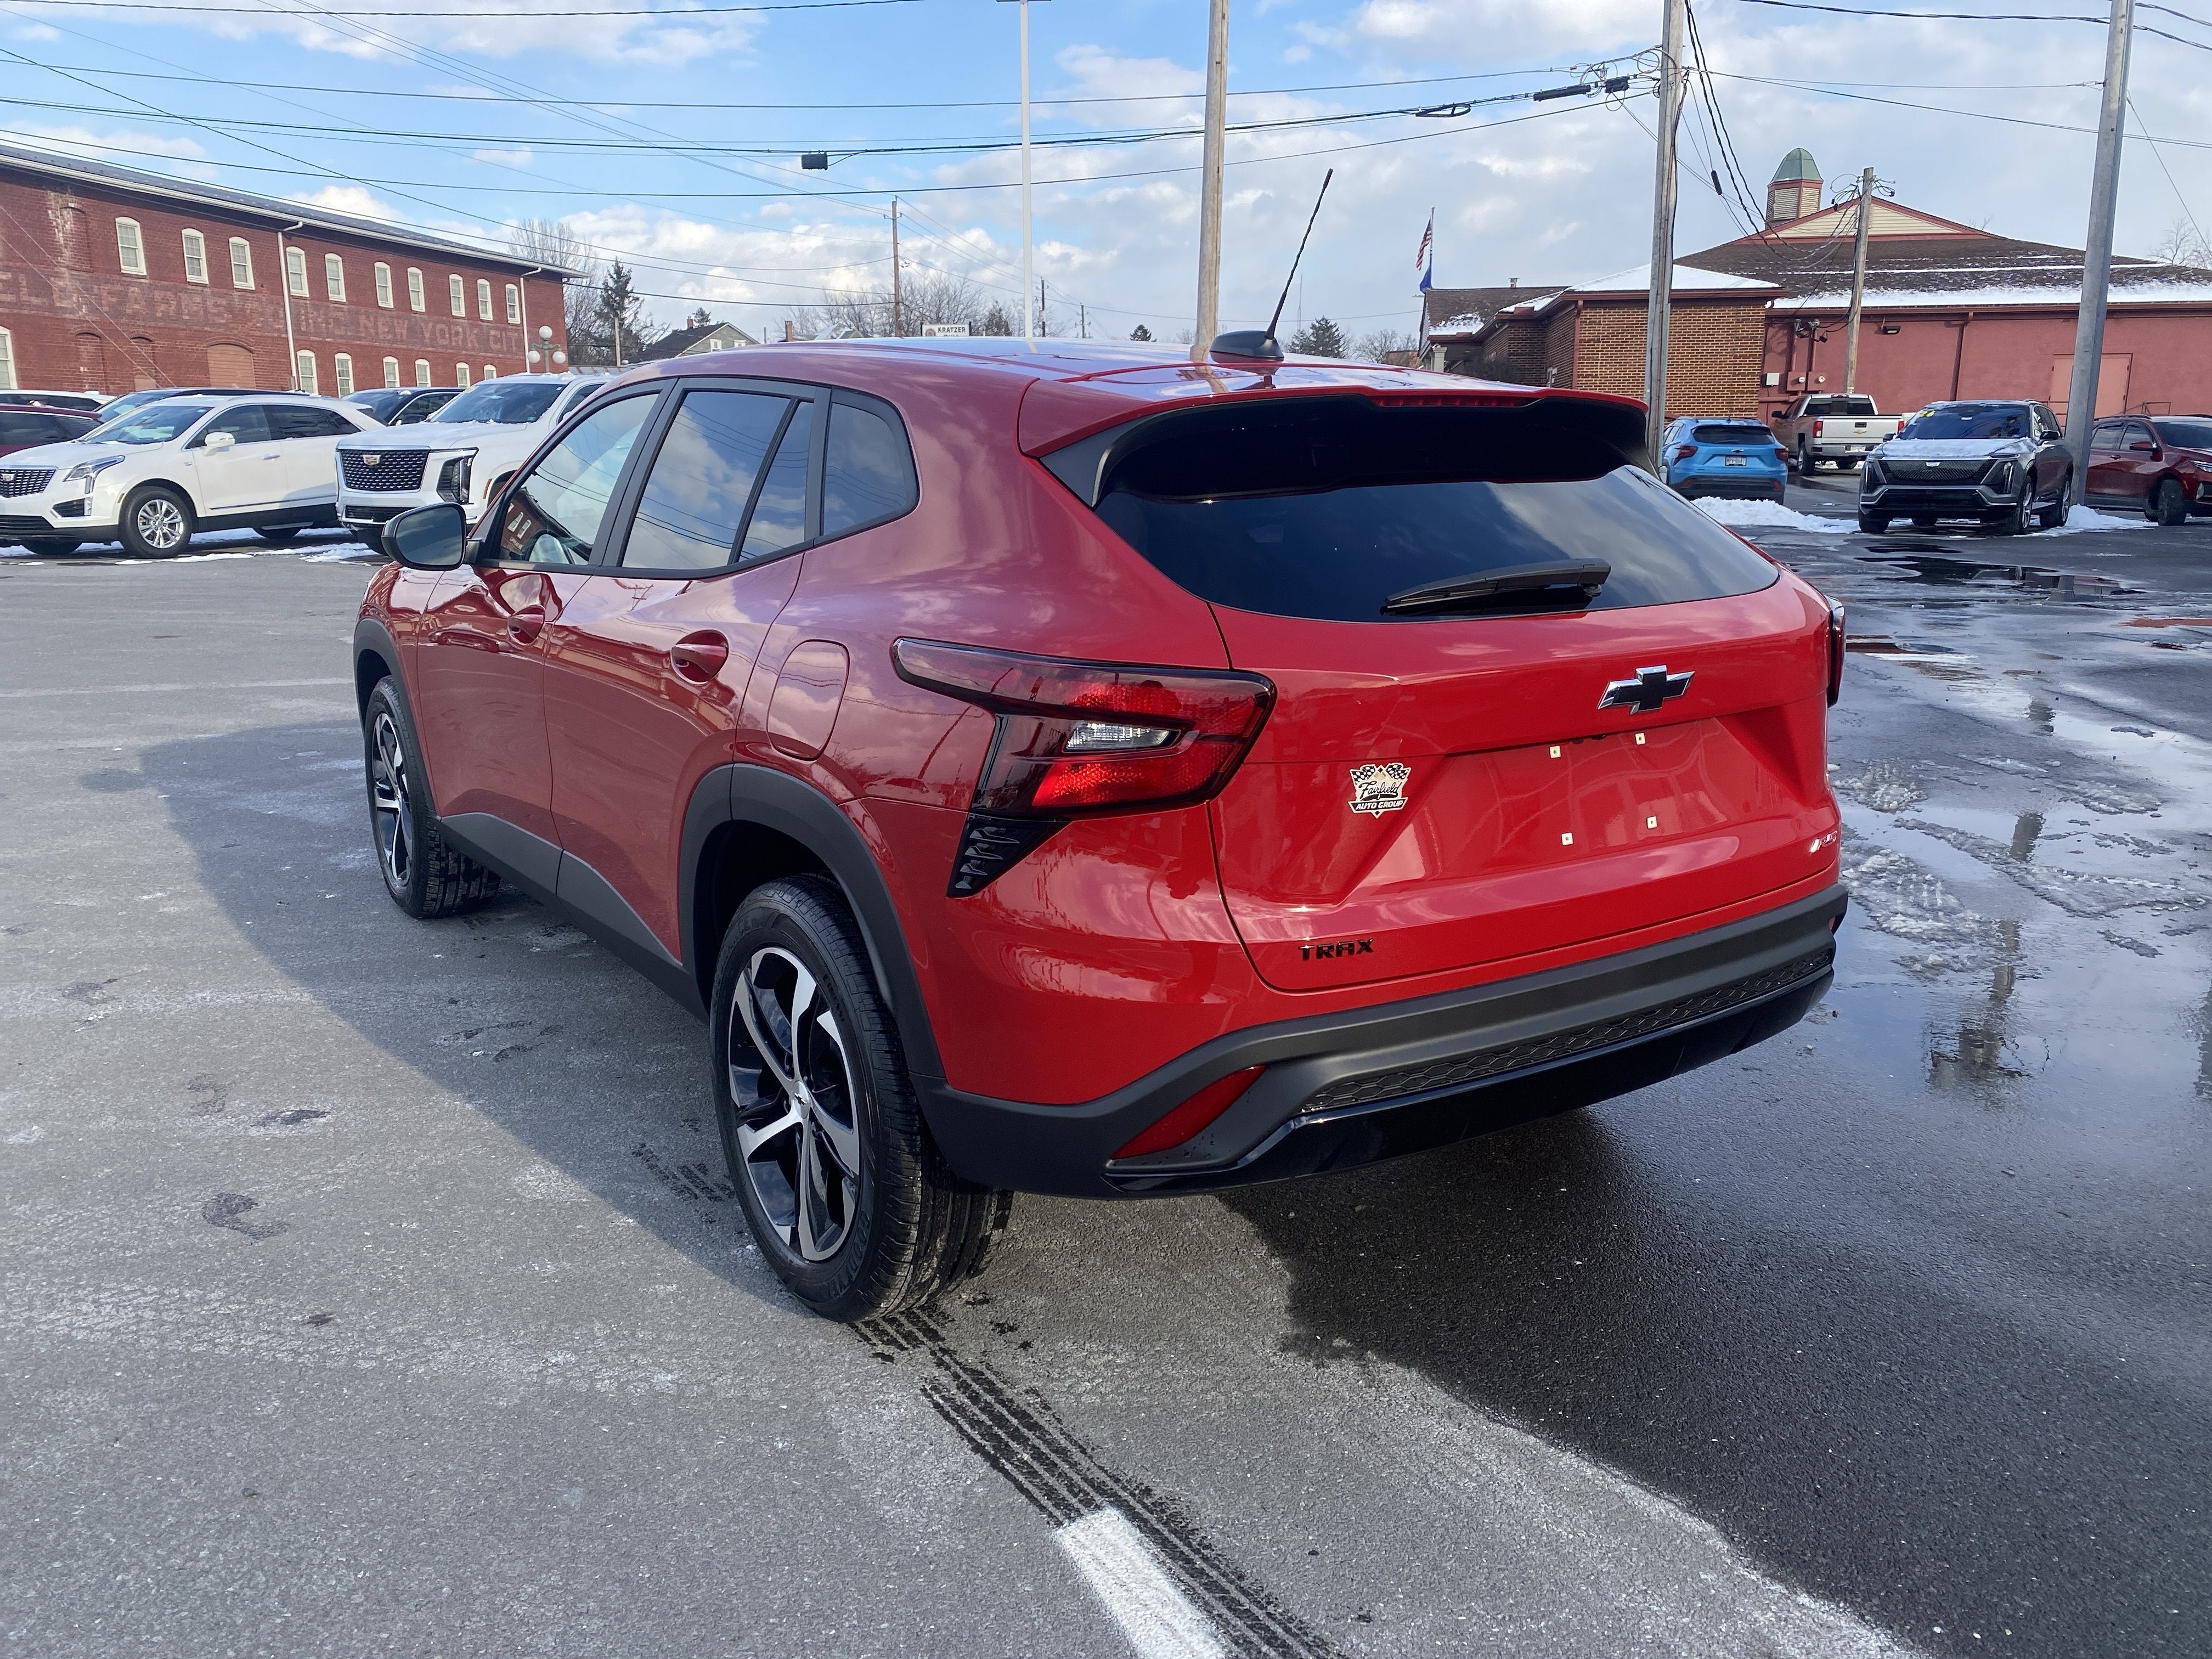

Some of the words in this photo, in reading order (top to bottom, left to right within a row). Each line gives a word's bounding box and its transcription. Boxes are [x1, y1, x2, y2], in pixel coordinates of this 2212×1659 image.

[359, 314, 409, 342] NEW
[421, 321, 479, 351] YORK
[489, 329, 524, 353] CIT
[1358, 781, 1402, 800] Fairfield
[1378, 800, 1403, 809] GROUP
[1297, 938, 1375, 961] TRAX
